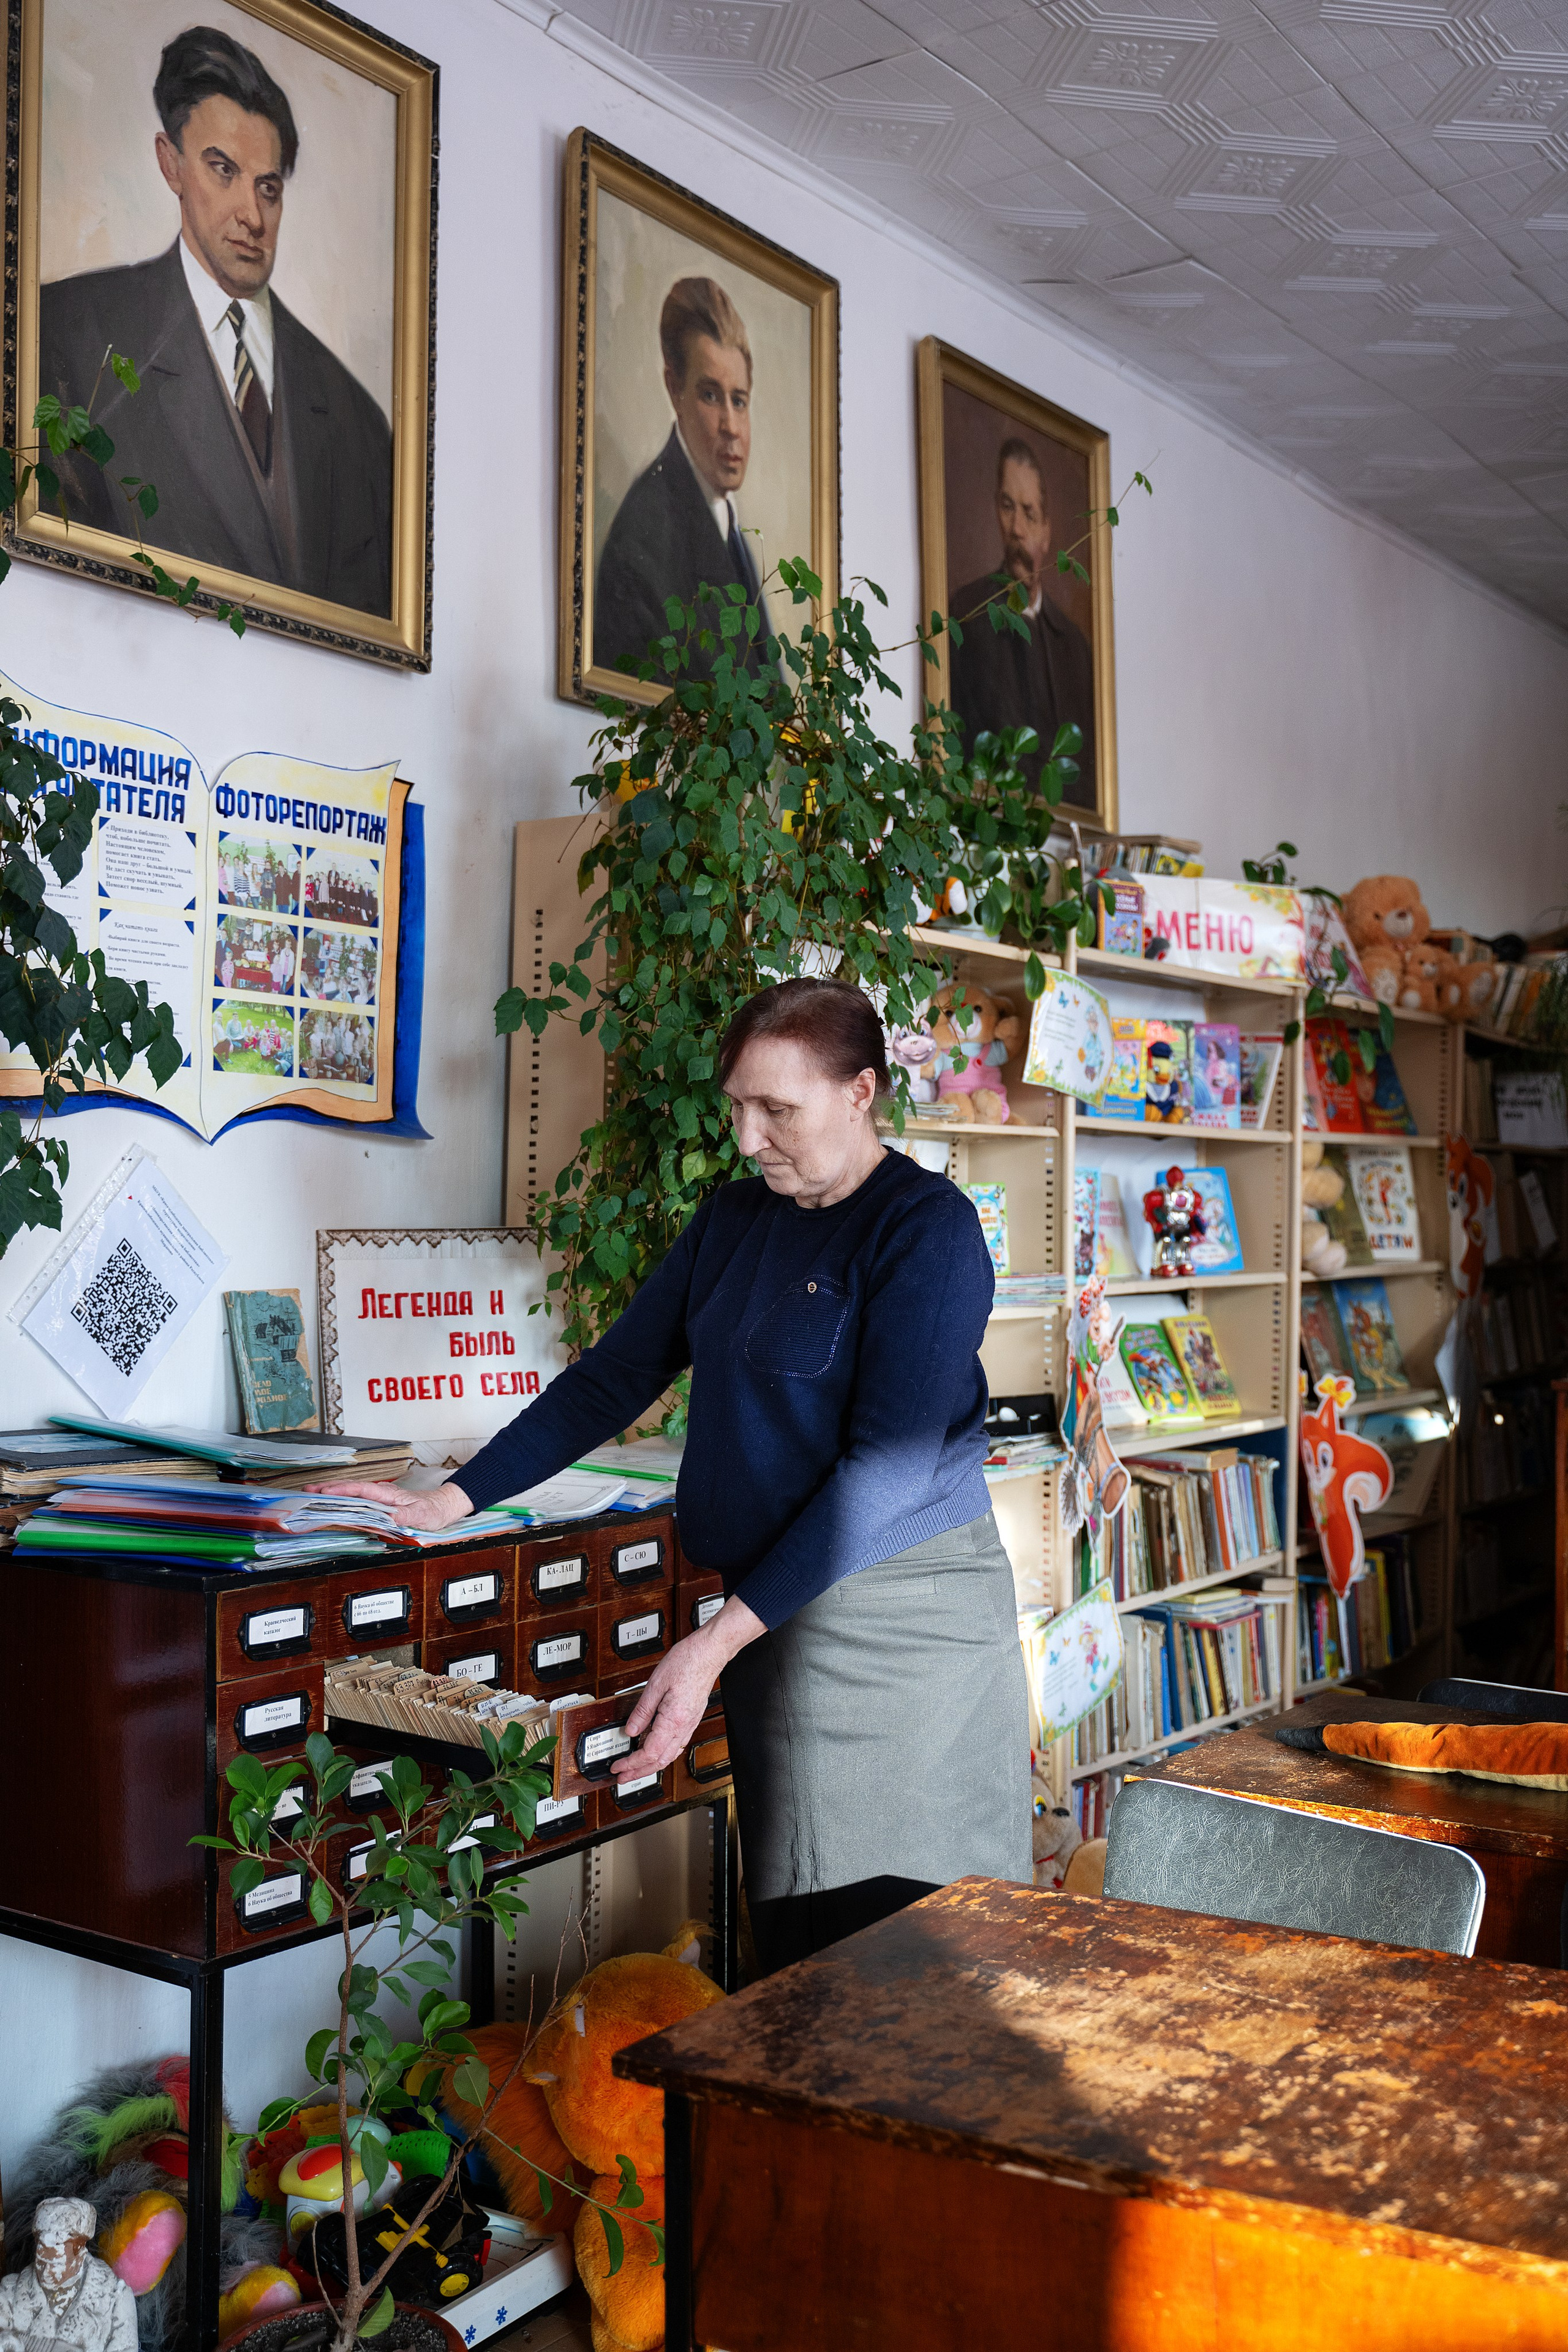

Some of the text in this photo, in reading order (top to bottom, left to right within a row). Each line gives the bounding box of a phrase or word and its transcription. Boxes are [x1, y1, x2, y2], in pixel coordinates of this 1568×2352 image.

[216, 782, 387, 845] ФОТОРЕПОРТАЖ
[106, 840, 136, 850] Настоящим
[146, 862, 169, 872] большой
[1156, 910, 1254, 954] МЕНЮ
[449, 1330, 516, 1357] БЫЛЬ
[368, 1371, 541, 1403] СВОЕГО СЕЛА
[635, 1550, 646, 1560] СЮ
[358, 1602, 371, 1611] Наука
[264, 1615, 297, 1628] Краеведческий
[263, 1627, 281, 1636] каталог
[636, 1626, 647, 1637] ЦЫ
[456, 1668, 467, 1678] БО
[473, 1663, 483, 1673] ГЕ
[265, 1706, 284, 1714] Русская
[264, 1712, 292, 1722] литература
[590, 1738, 614, 1749] Языкознание
[591, 1745, 614, 1756] Справочные
[352, 1779, 372, 1789] указатель
[252, 1888, 275, 1898] Медицина
[272, 1891, 293, 1899] общества
